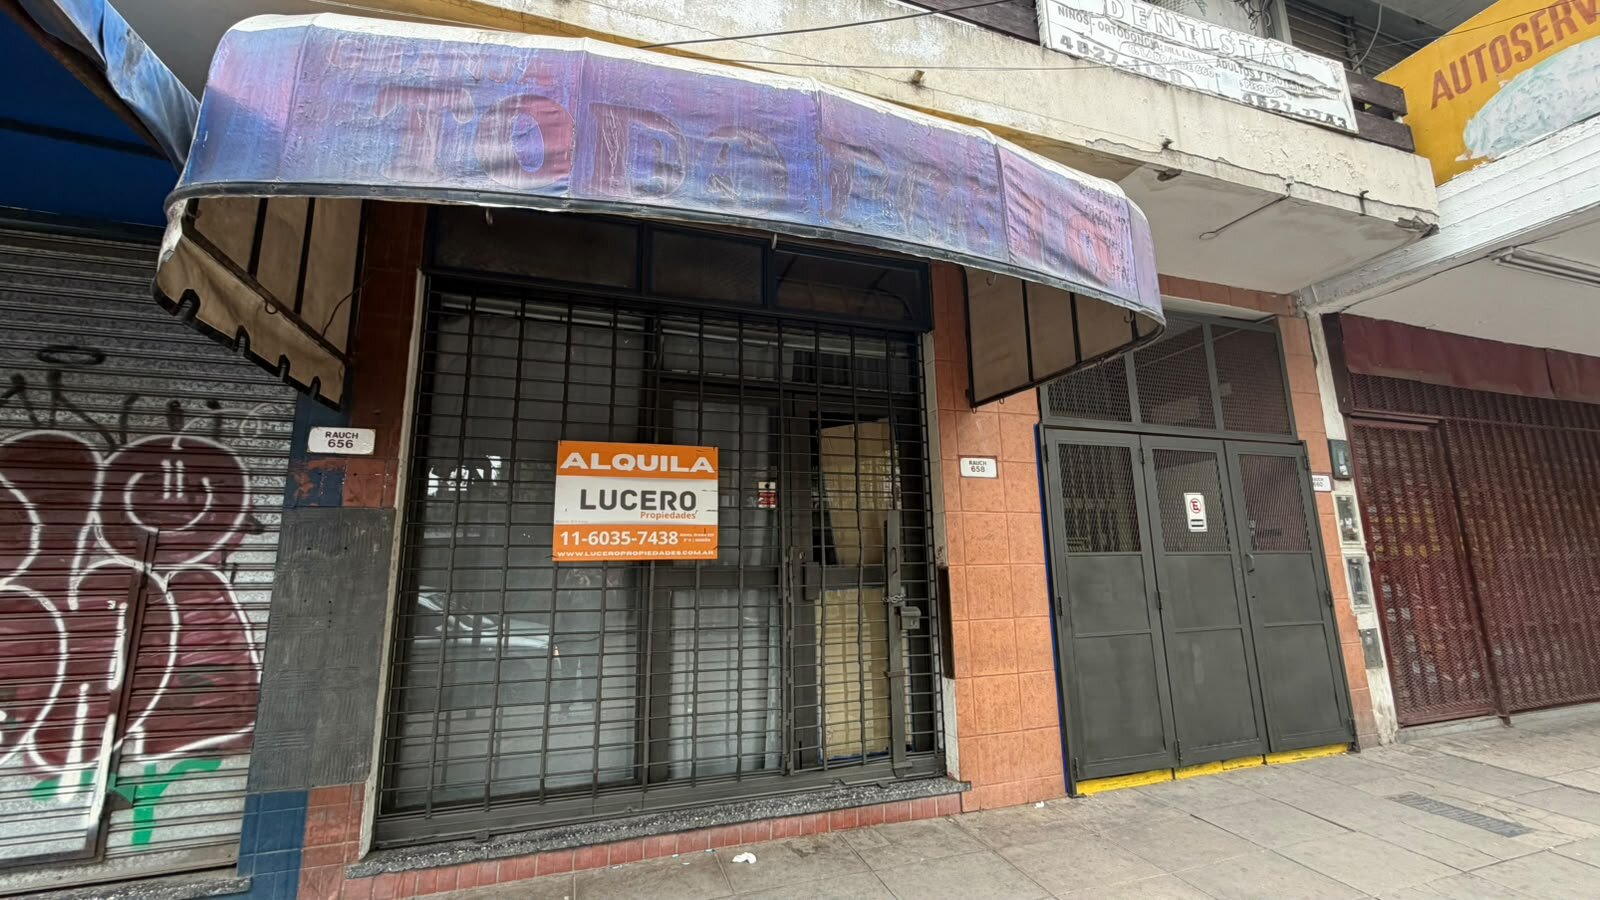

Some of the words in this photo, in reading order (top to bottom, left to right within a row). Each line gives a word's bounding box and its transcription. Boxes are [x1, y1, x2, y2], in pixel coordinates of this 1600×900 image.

[1106, 0, 1296, 72] DENTISTAS
[325, 431, 359, 439] RAUCH
[328, 439, 353, 448] 656
[560, 452, 715, 473] ALQUILA
[580, 489, 697, 511] LUCERO
[640, 511, 696, 520] Propiedades
[560, 531, 679, 546] 11-6035-7438
